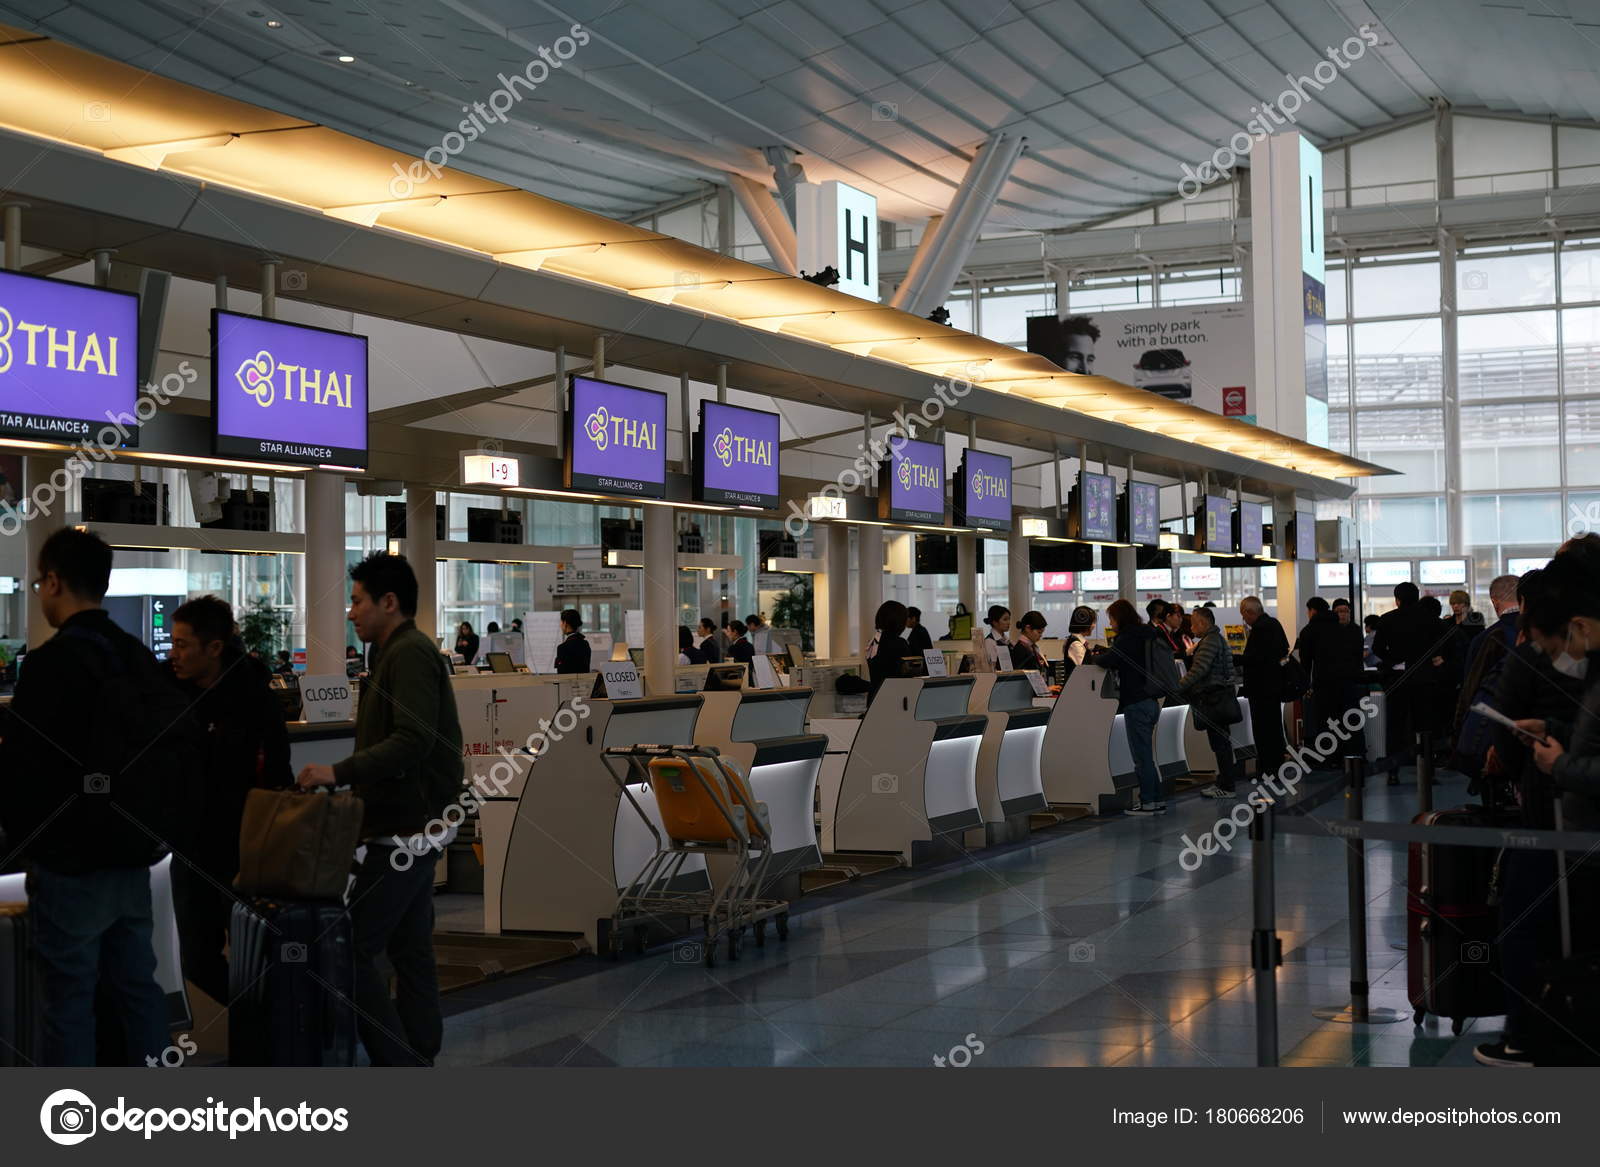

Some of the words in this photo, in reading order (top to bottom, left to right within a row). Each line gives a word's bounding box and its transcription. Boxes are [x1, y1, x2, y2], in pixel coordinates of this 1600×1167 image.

[845, 208, 870, 287] H
[1124, 322, 1168, 335] Simply
[1171, 319, 1201, 332] park
[16, 320, 118, 377] THAI
[1117, 336, 1146, 348] with
[1149, 338, 1157, 346] a
[1160, 333, 1208, 346] button.
[276, 362, 353, 409] THAI
[0, 414, 23, 428] TAR
[25, 417, 80, 434] ALLIANCE
[610, 415, 657, 451] THAI
[260, 441, 283, 455] STAR
[284, 444, 325, 458] ALLIANCE
[734, 434, 772, 467] THAI
[598, 477, 613, 487] STAR
[613, 479, 639, 490] ALLIANCE
[912, 464, 939, 489] THAI
[984, 475, 1007, 498] THAI
[724, 491, 737, 500] STAR
[737, 493, 758, 503] ALLIANCE
[606, 671, 636, 683] CLOSED
[305, 687, 348, 702] CLOSED
